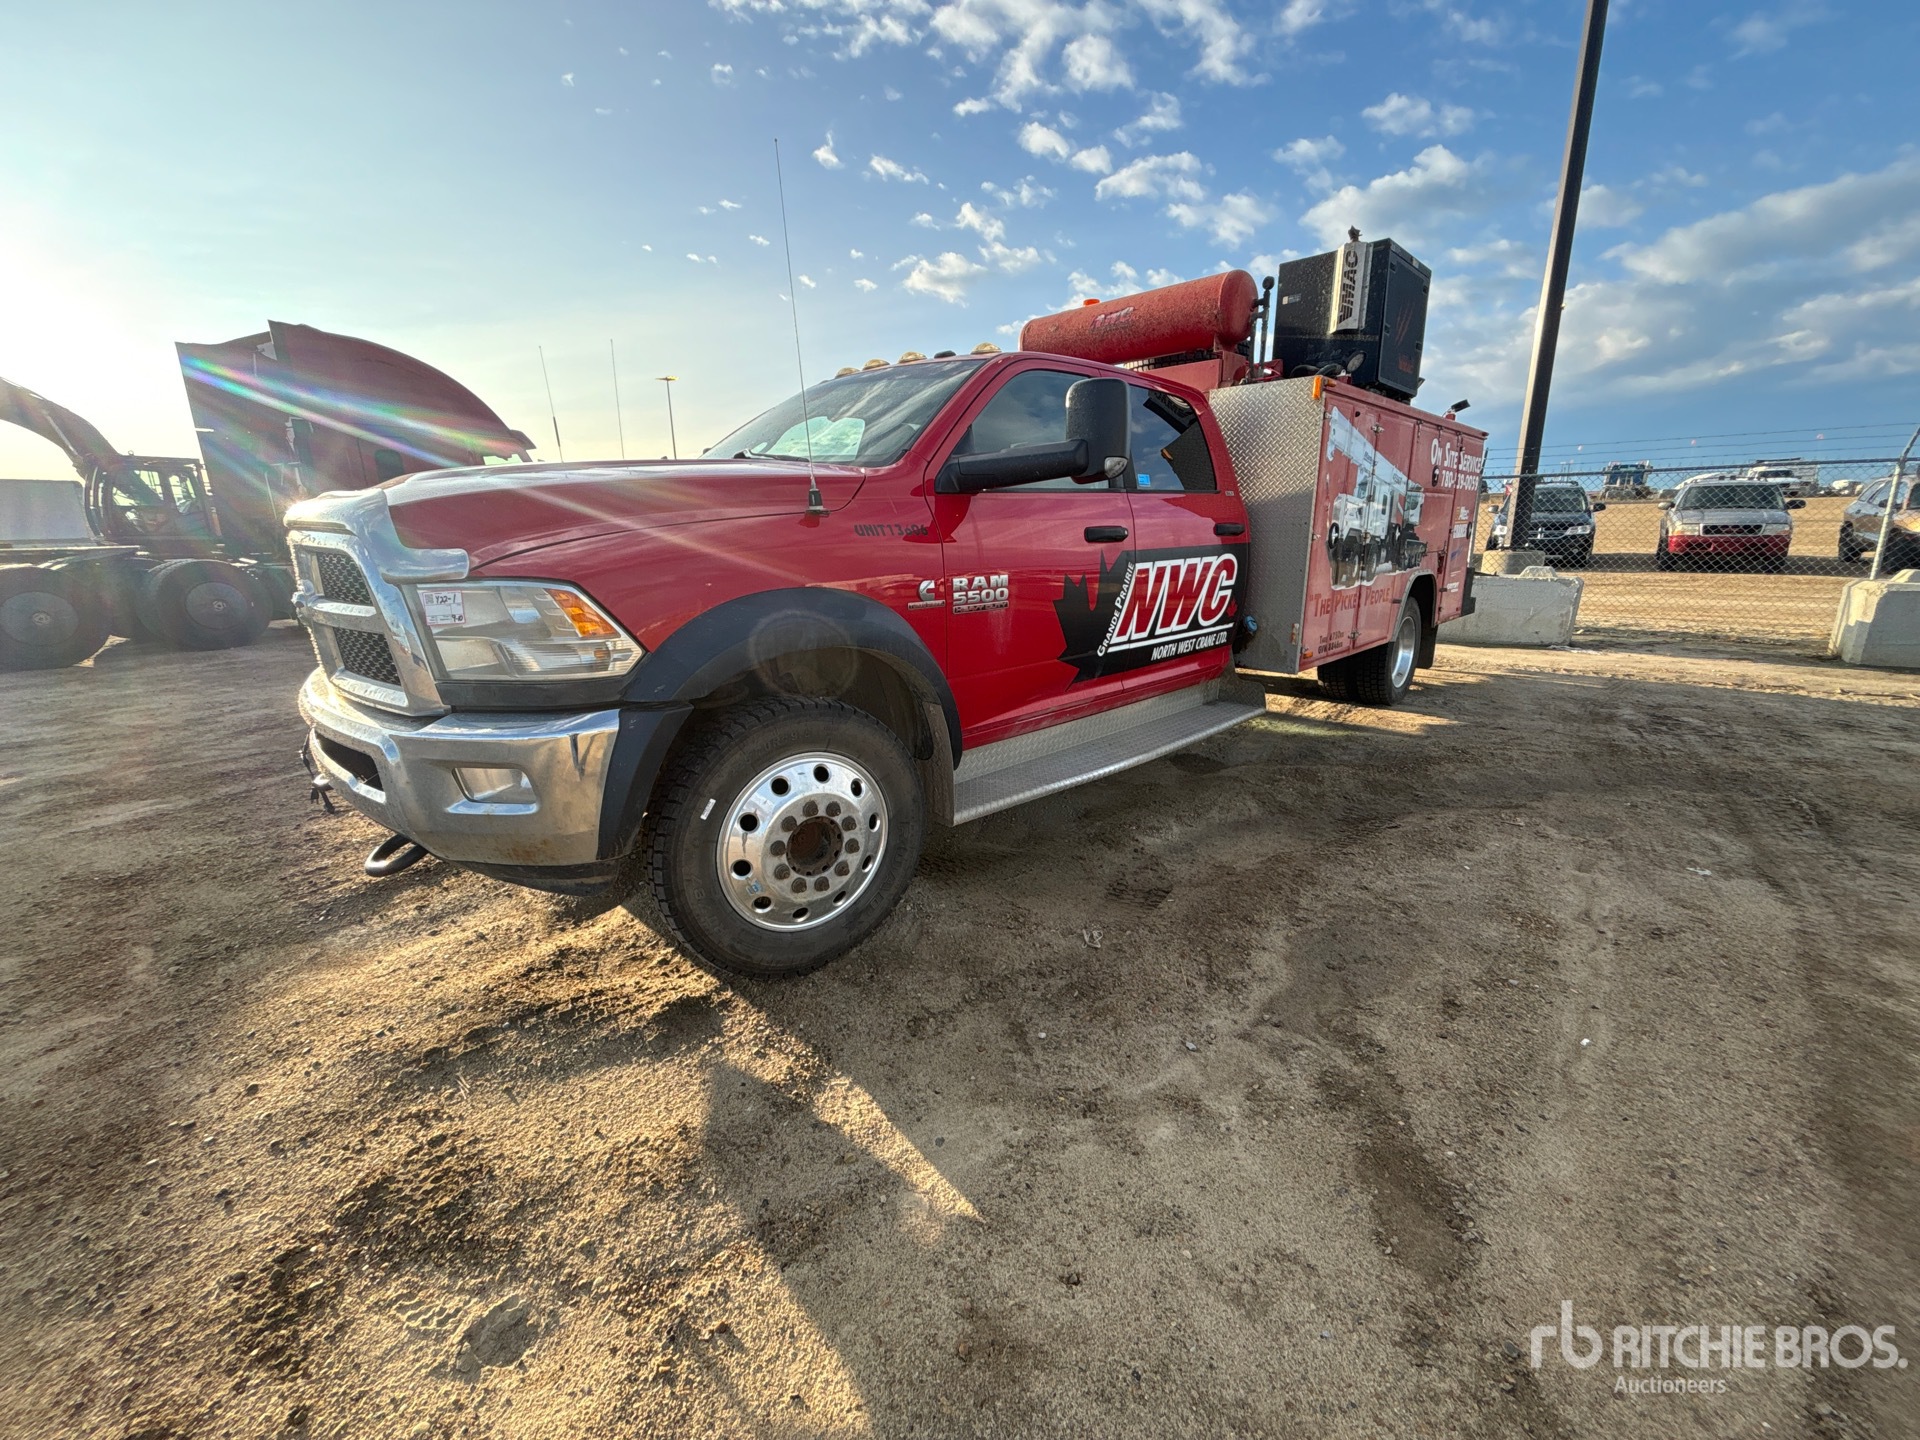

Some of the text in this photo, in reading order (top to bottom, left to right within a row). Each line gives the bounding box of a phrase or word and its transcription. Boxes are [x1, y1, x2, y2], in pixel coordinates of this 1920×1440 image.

[1338, 250, 1359, 324] VMAC
[953, 574, 1009, 591] RAM
[953, 588, 1009, 606] 5500
[1110, 553, 1238, 645] NWC
[1334, 591, 1361, 613] PICKE
[1151, 644, 1177, 661] NORTH
[1177, 638, 1196, 656] WEST
[1195, 633, 1217, 651] CRANE
